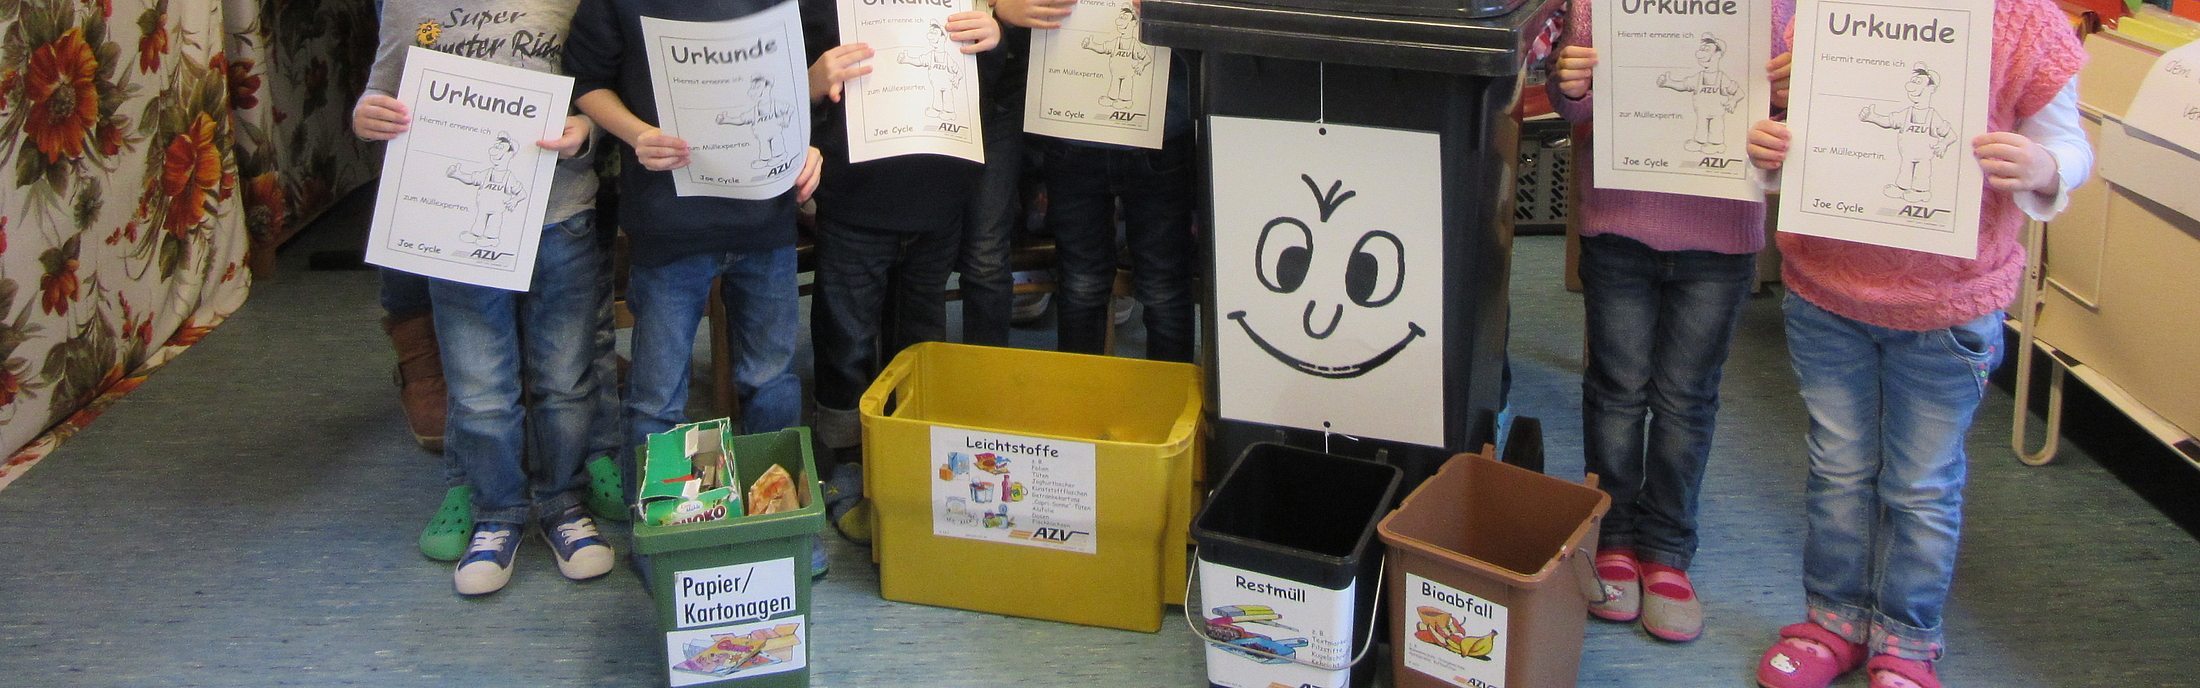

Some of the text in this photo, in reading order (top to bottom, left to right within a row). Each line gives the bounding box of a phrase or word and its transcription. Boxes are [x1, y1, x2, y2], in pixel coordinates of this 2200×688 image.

[441, 7, 527, 31] Super
[1829, 12, 1955, 44] Urkunde
[671, 38, 777, 65] Urkunde
[1821, 53, 1905, 68] Hiermit ernenne ich
[430, 80, 537, 119] Urkunde
[1048, 108, 1084, 119] Joe Cycle
[1109, 111, 1146, 121] AZV
[420, 115, 448, 127] Hiermit
[480, 126, 491, 135] ich
[874, 125, 914, 136] Joe Cycle
[938, 122, 968, 133] AZV
[1906, 125, 1928, 134] AZV
[767, 157, 796, 178] AZV
[1623, 157, 1668, 168] Joe Cycle
[1699, 157, 1742, 168] AZV
[1812, 198, 1864, 214] Joe Cycle
[1898, 205, 1950, 218] AZV
[398, 238, 441, 254] Joe Cycle
[470, 249, 514, 260] AZV
[966, 436, 1059, 458] Leichtstoffe
[1032, 527, 1090, 542] AZV
[683, 566, 754, 600] Papier/
[1236, 575, 1306, 602] Restmüll
[1422, 581, 1493, 620] Bioabfall
[684, 594, 791, 624] Kartonagen
